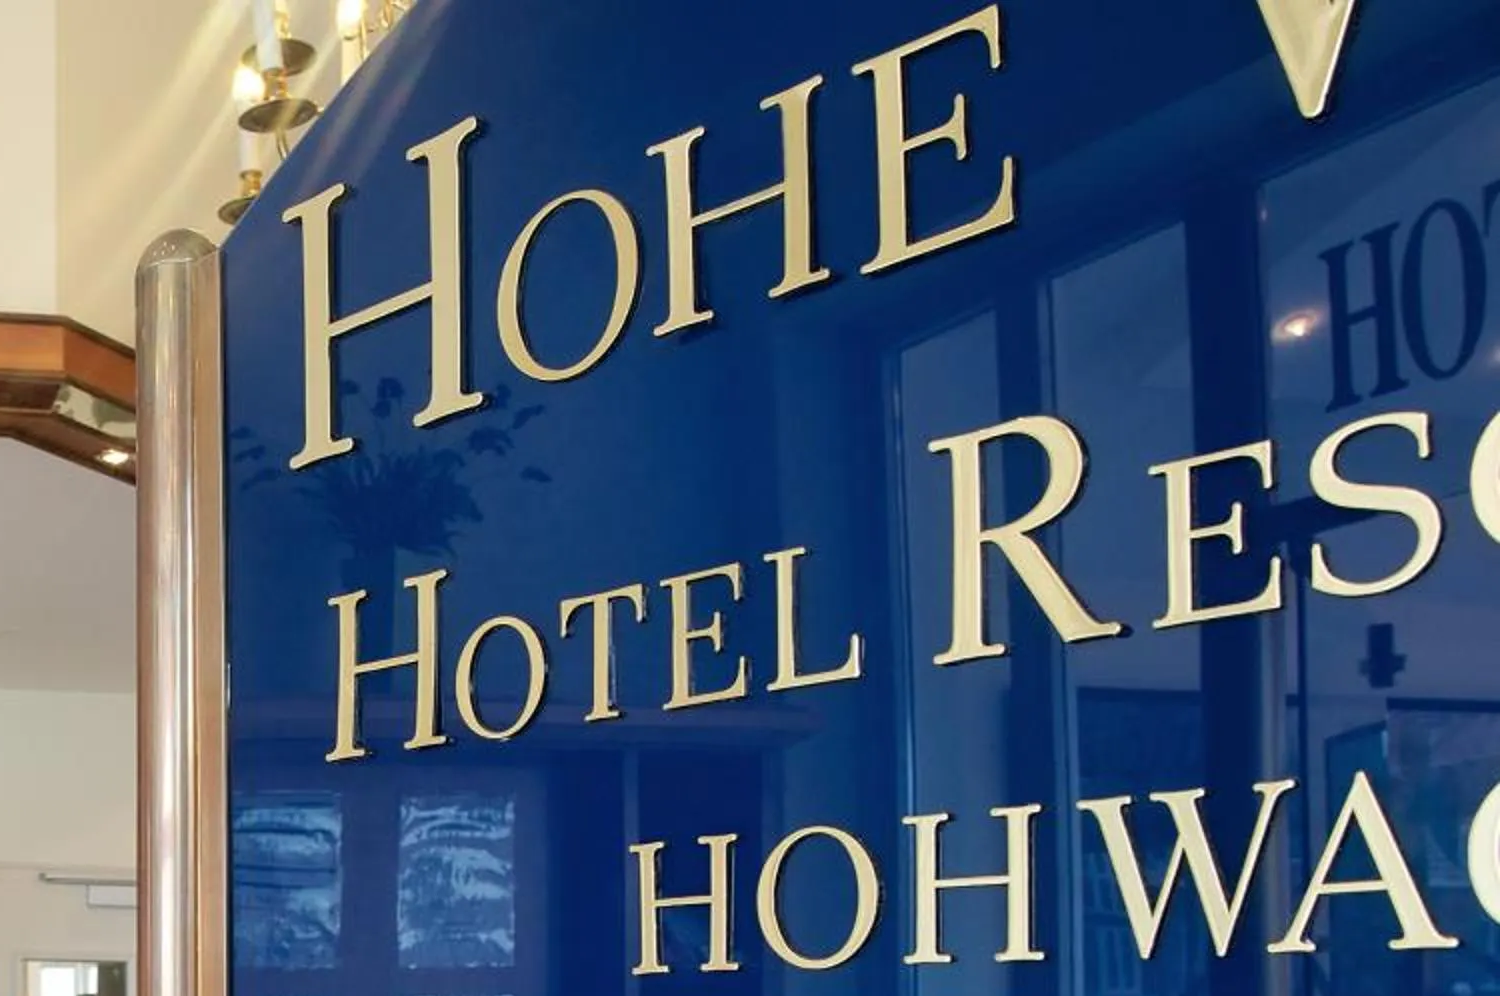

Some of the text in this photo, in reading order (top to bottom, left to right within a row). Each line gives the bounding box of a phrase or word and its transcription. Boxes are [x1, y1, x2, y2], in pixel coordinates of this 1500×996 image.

[281, 5, 1016, 471] HOHE
[1318, 180, 1500, 413] HO
[325, 411, 1500, 762] HOTEL RES
[629, 771, 1500, 976] HOHWA
